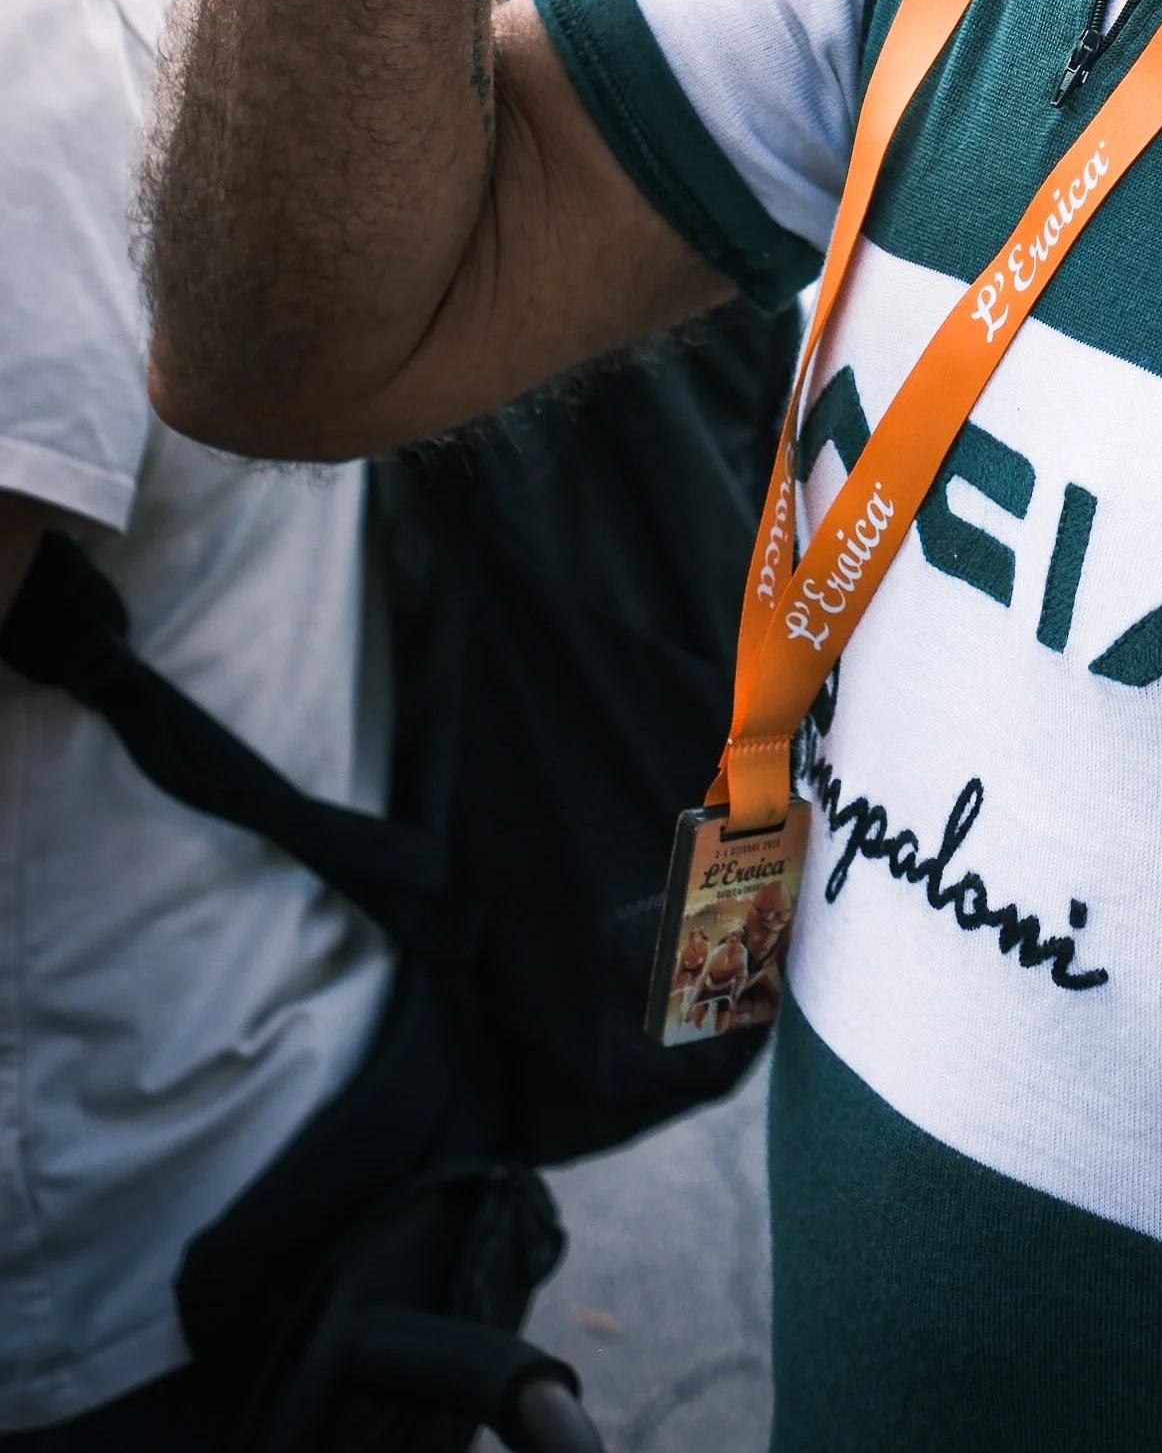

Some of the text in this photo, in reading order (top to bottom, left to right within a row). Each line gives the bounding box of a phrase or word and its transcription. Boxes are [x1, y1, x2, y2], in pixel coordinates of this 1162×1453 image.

[971, 140, 1109, 343] L'Eroica
[785, 481, 894, 651] L'Eroica
[699, 857, 785, 890] L'Eroica
